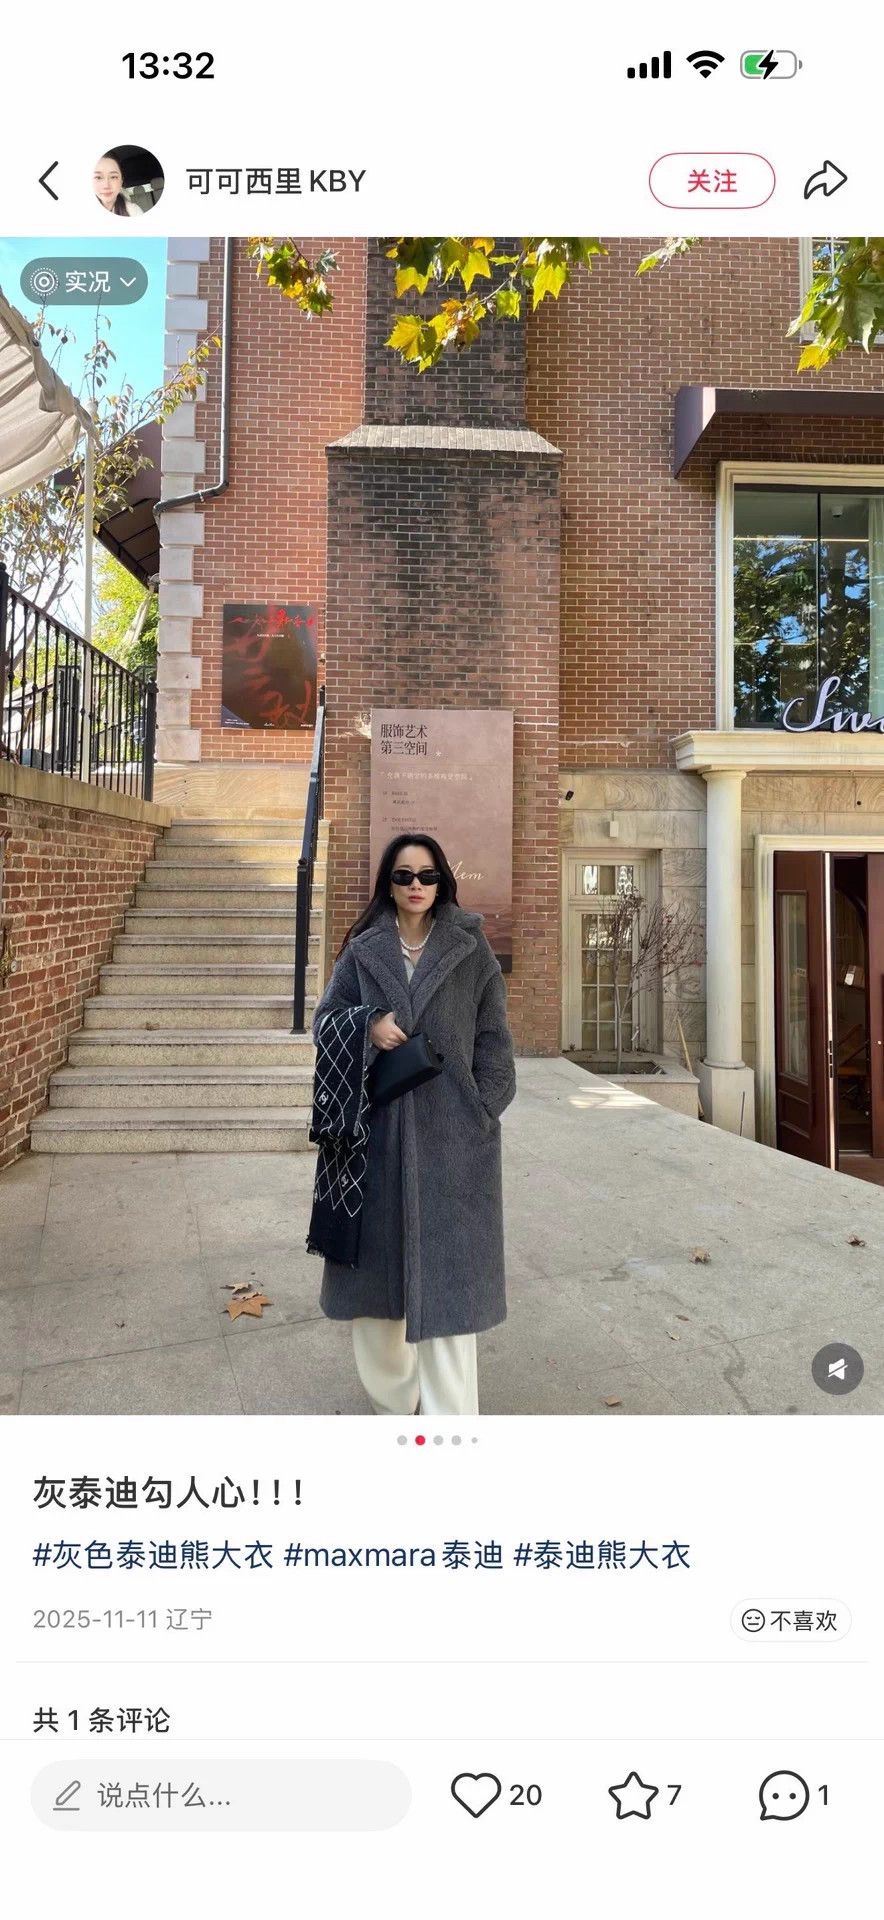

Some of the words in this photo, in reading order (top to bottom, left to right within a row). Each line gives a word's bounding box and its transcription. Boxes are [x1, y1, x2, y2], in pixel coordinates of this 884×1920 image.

[380, 723, 428, 739] 服饰艺术
[380, 740, 428, 756] 第三空间
